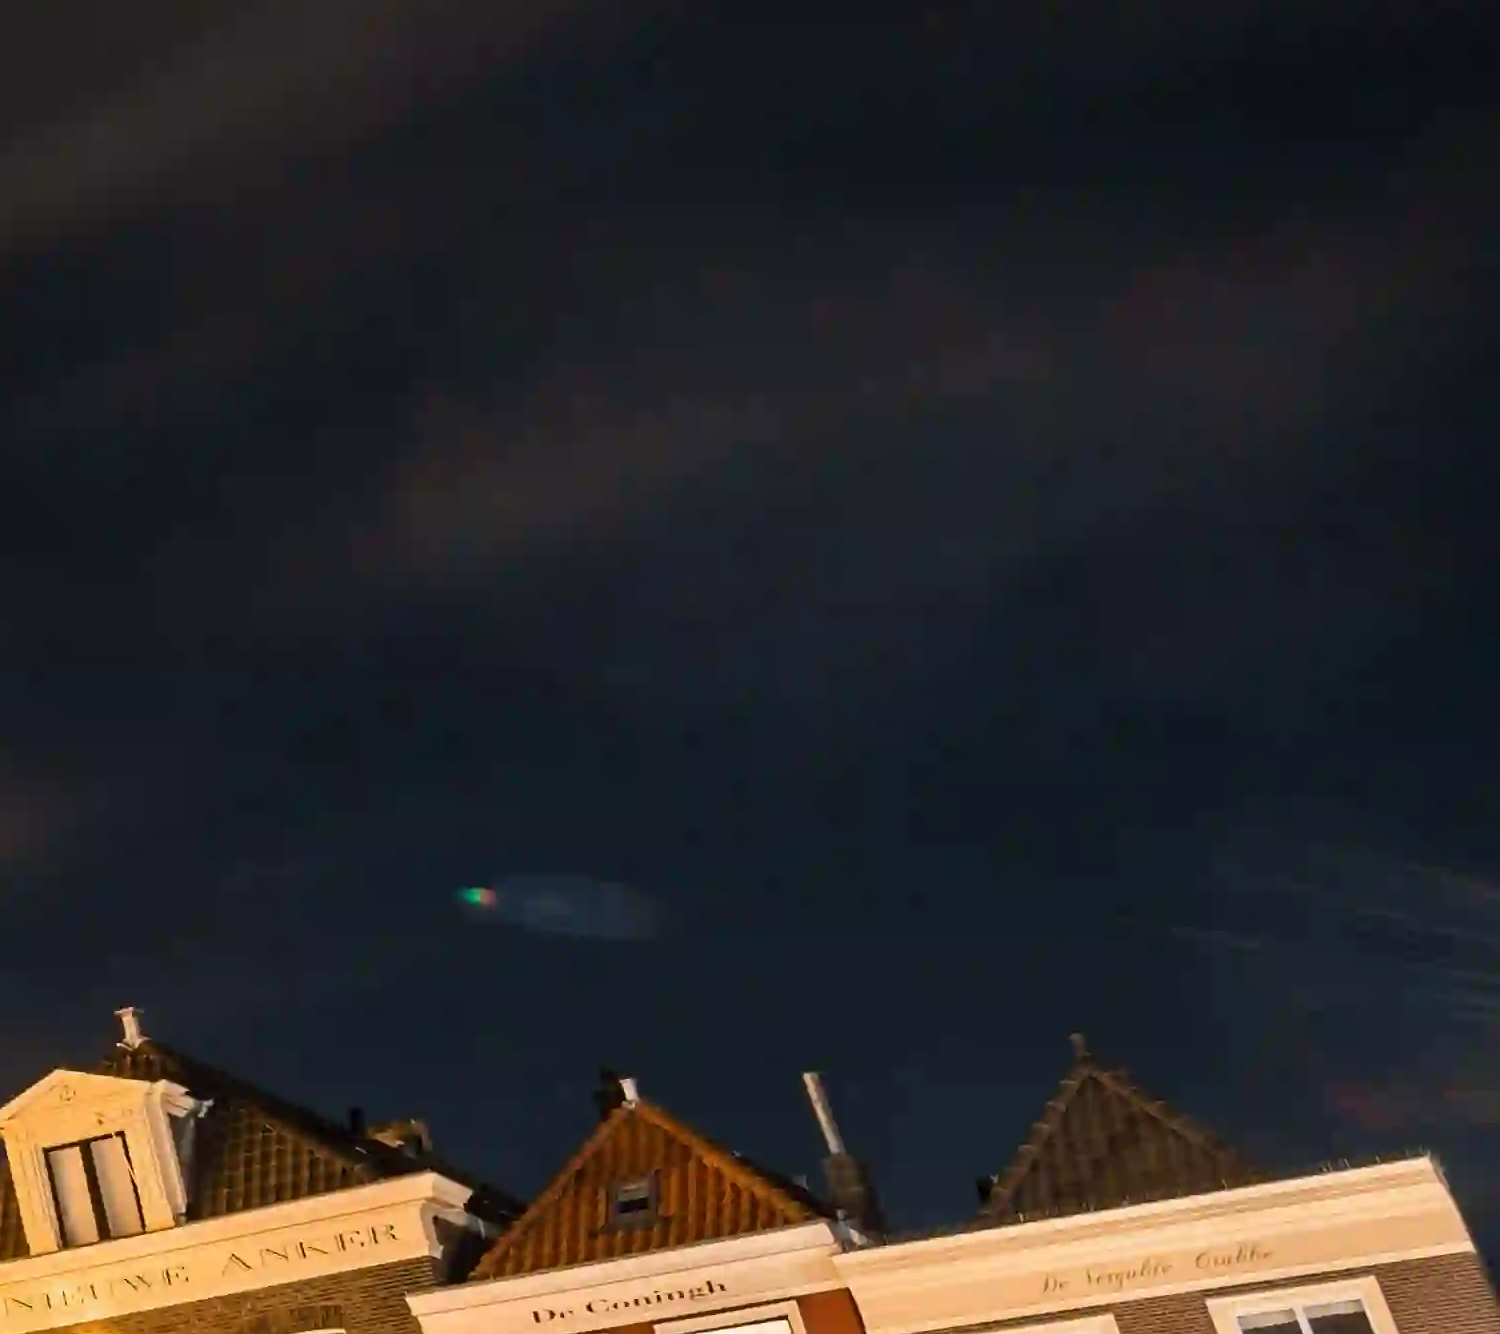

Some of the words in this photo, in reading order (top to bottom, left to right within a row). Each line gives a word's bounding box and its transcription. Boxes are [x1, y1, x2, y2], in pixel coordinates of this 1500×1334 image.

[4, 1265, 190, 1317] NIEUWE
[221, 1221, 400, 1277] ANKER
[532, 1309, 574, 1324] De
